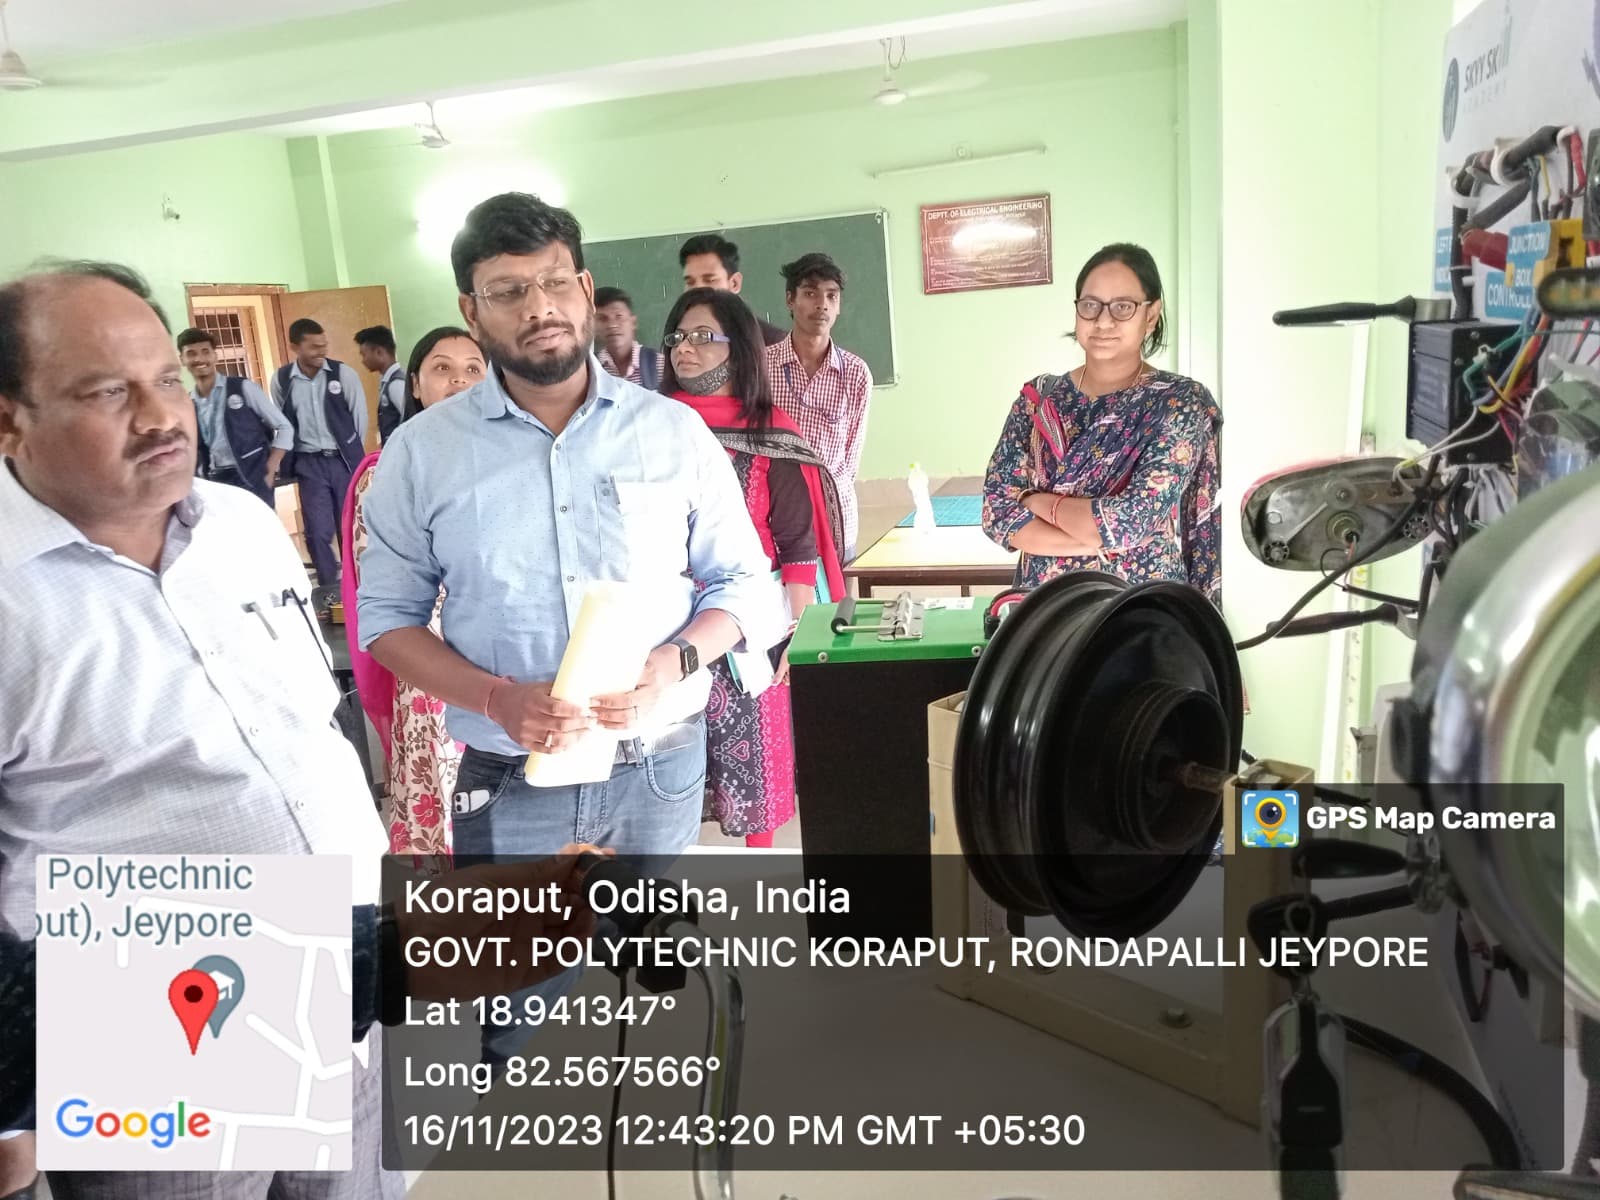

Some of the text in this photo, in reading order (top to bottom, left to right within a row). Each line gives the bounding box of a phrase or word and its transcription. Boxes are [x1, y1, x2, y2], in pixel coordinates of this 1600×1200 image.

[950, 210, 960, 218] OF
[960, 205, 999, 217] ELECTRICAL
[999, 200, 1043, 213] ENGINEERING
[1508, 231, 1547, 255] JUNCTION
[1515, 268, 1532, 287] BOX
